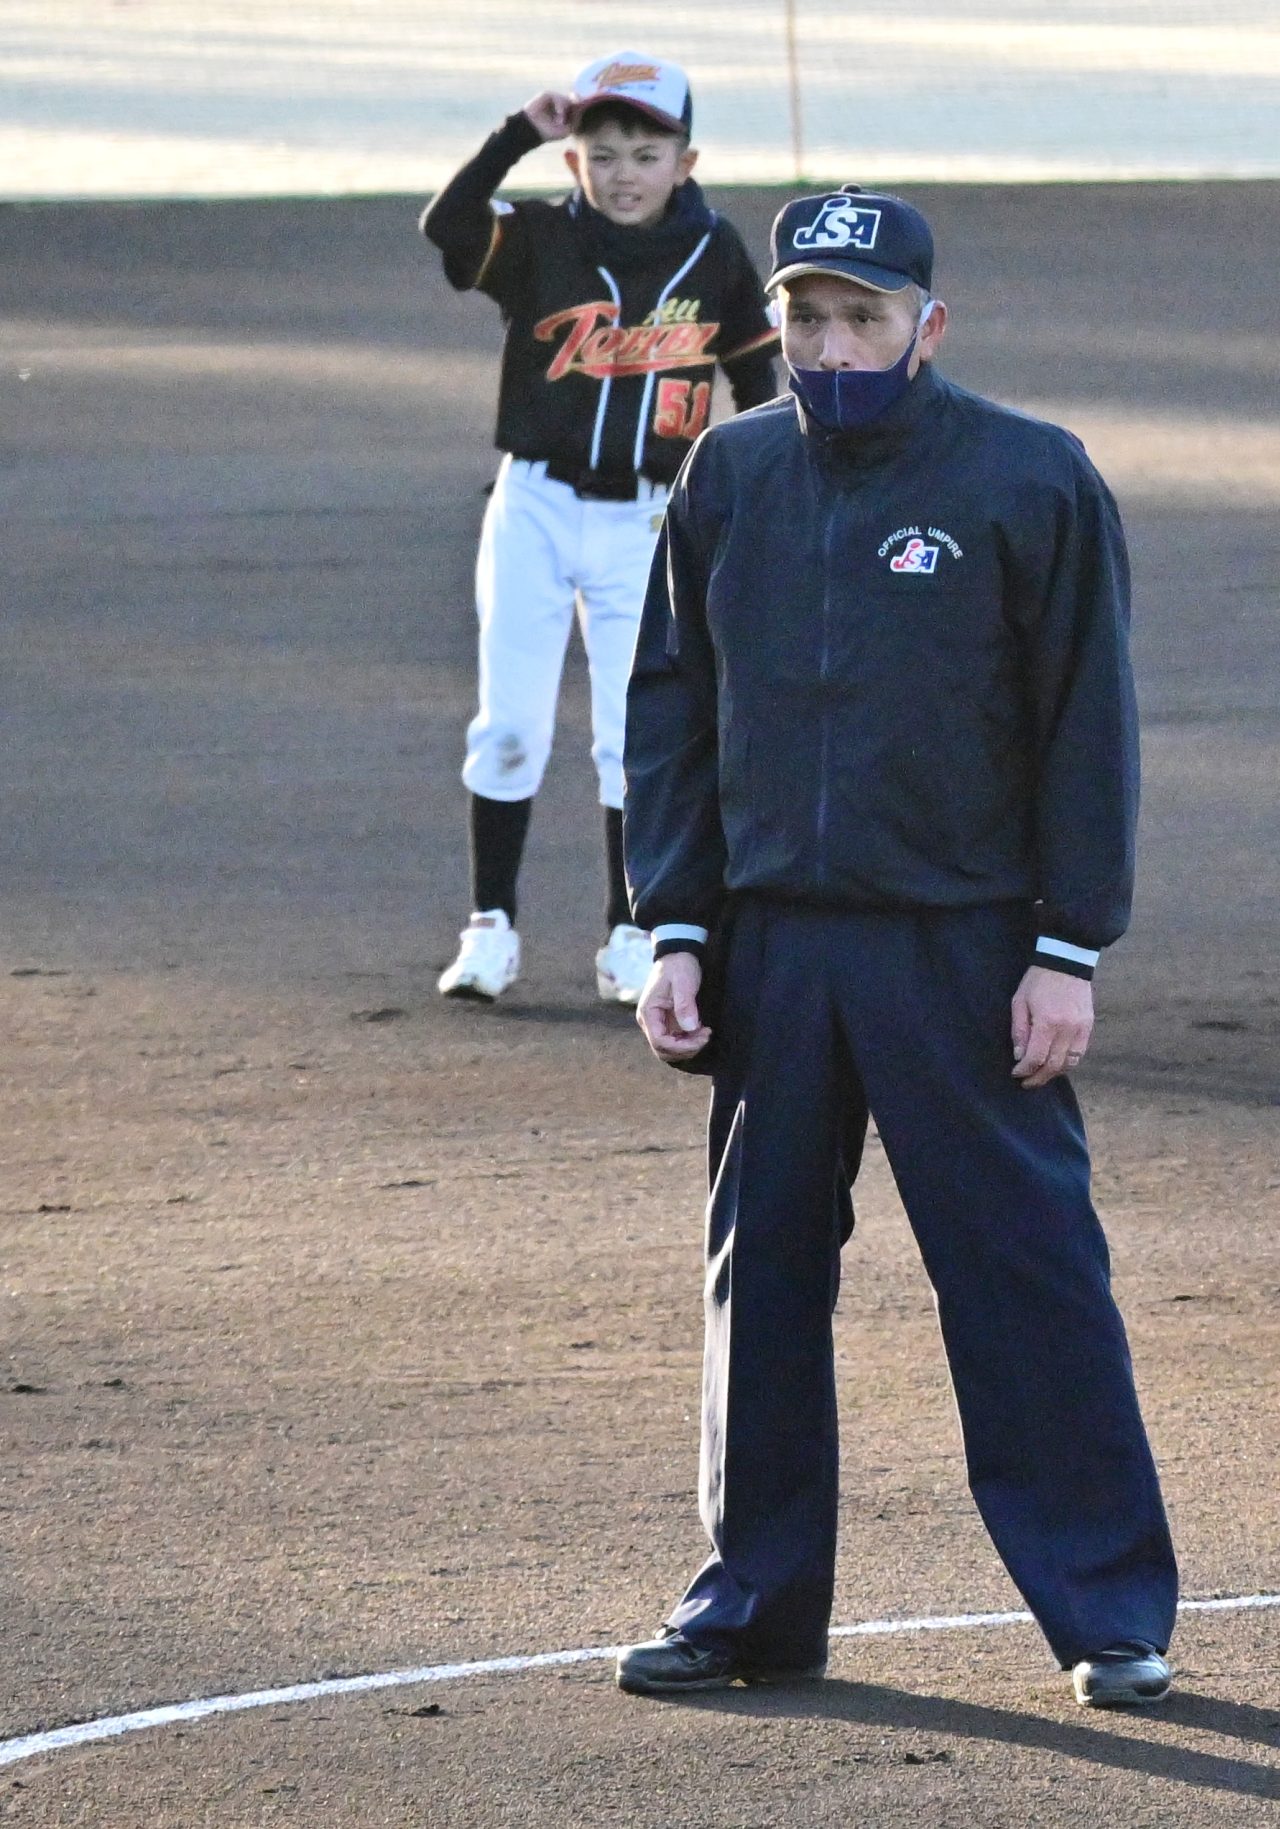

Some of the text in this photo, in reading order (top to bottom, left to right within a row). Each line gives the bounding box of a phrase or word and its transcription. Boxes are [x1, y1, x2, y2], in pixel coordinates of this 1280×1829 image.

[653, 377, 711, 441] 51
[878, 526, 964, 560] OFFICIAL UMPIRE
